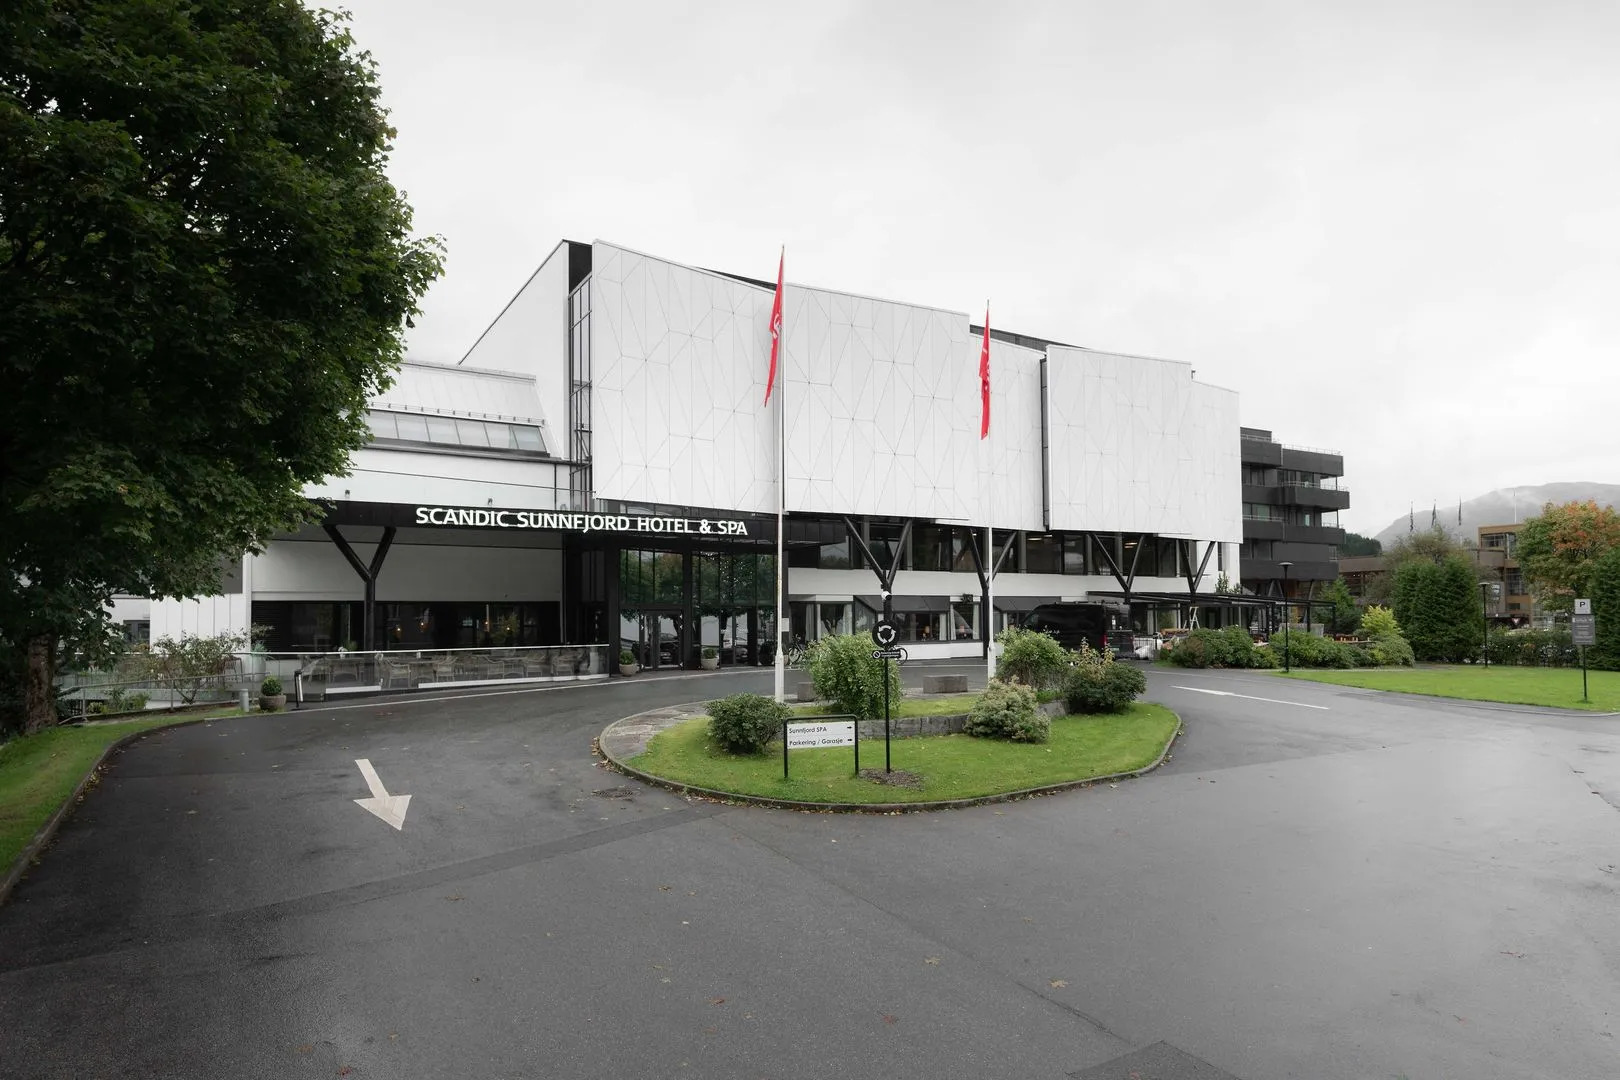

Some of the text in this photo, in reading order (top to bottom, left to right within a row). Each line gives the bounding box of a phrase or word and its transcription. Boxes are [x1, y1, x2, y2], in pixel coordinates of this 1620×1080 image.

[416, 507, 748, 536] SCANDIC SUNNFJORD HOTEL & SPA
